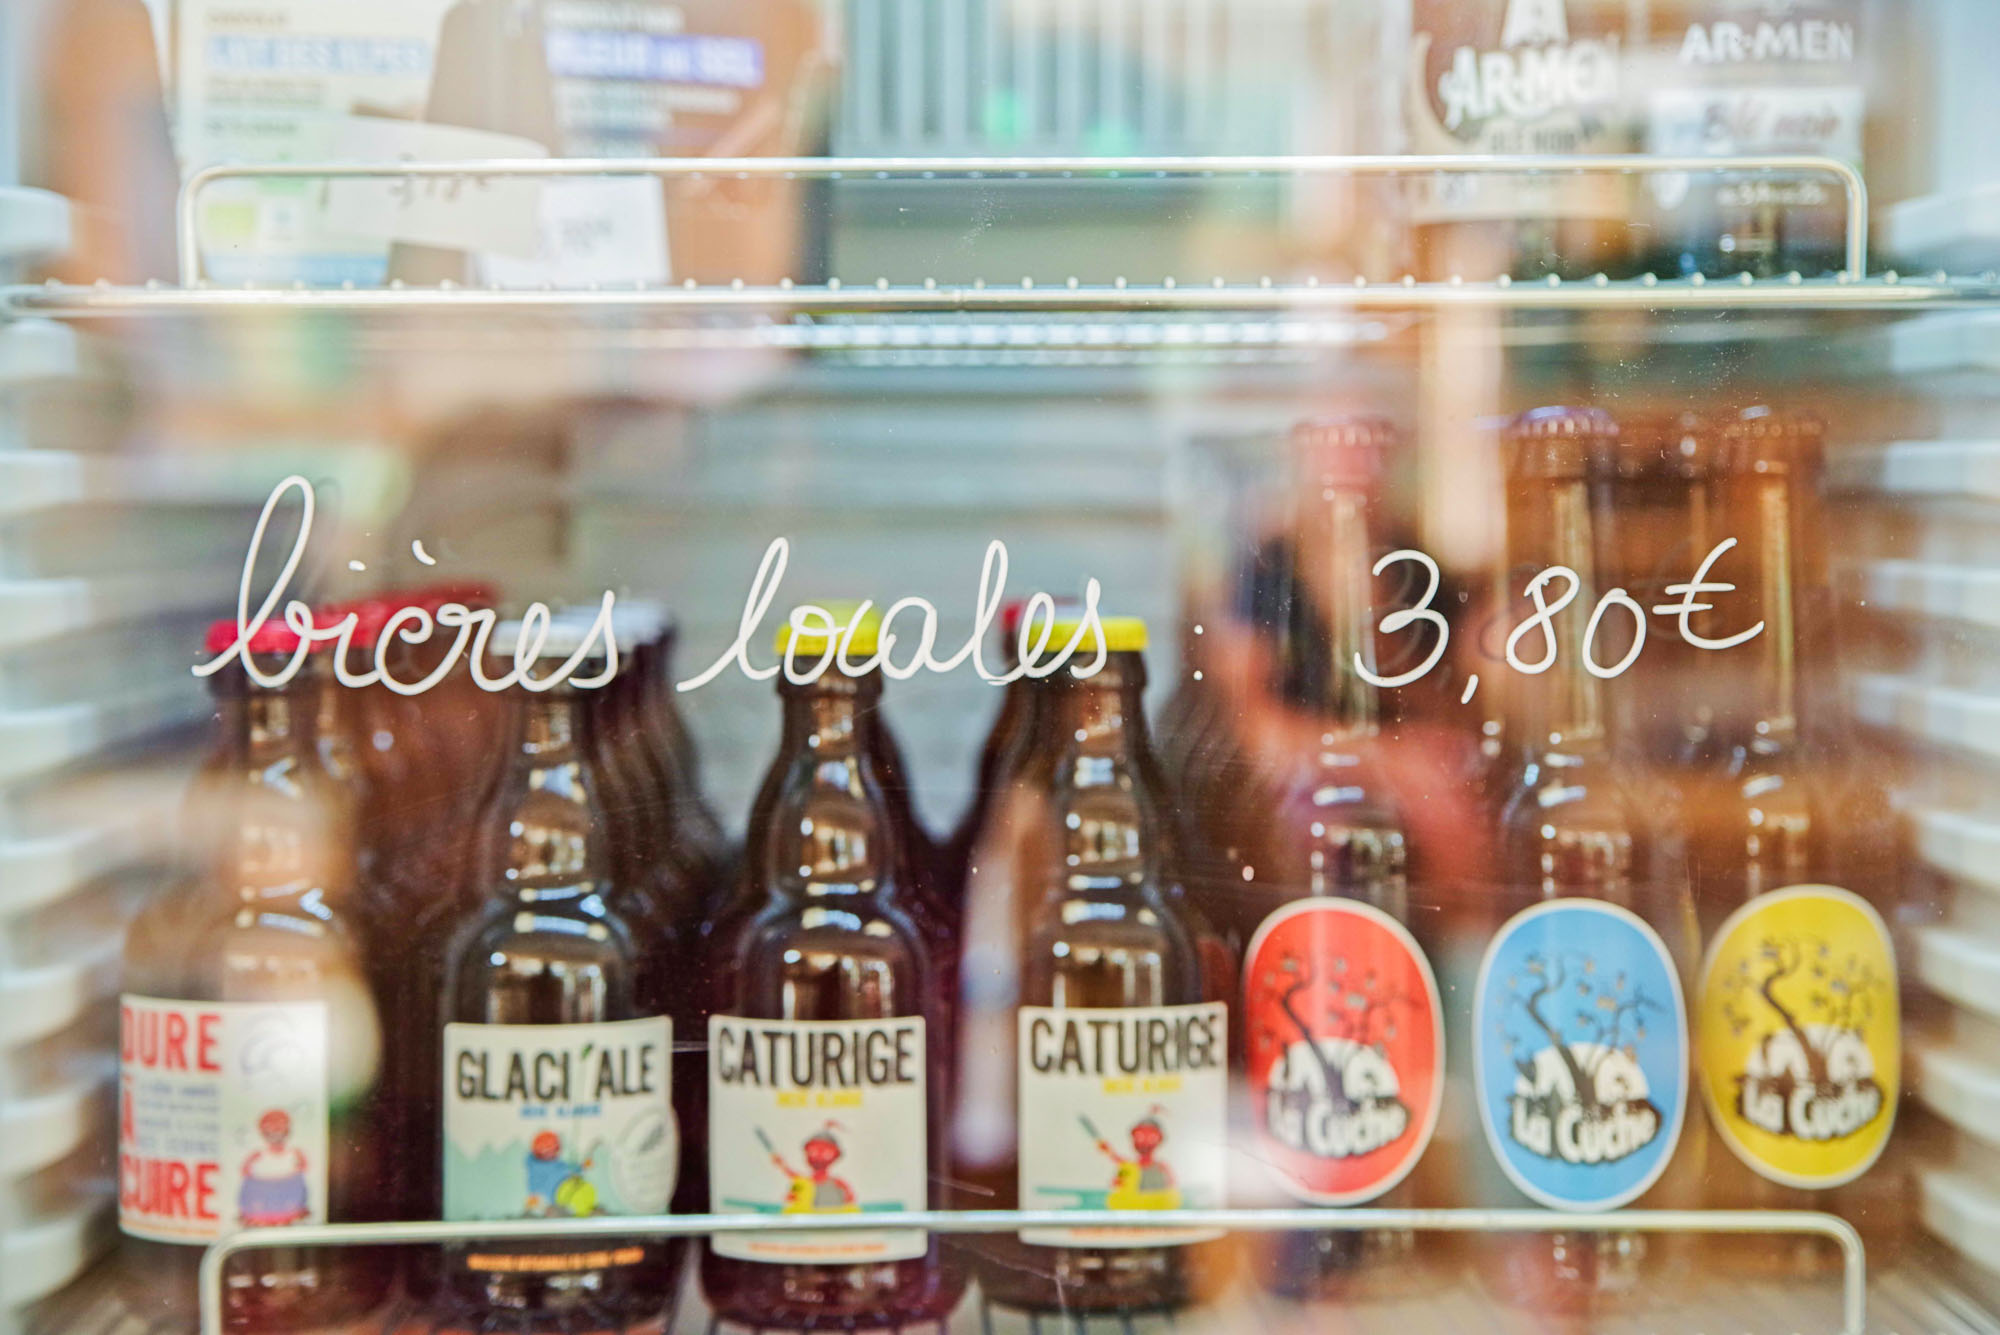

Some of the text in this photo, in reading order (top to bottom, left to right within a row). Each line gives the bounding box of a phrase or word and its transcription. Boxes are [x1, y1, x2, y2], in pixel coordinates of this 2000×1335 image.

[191, 475, 618, 696] bières
[676, 537, 1107, 692] locales
[1354, 537, 1765, 704] 3,80€
[718, 1027, 915, 1087] CATURIGE
[1031, 1014, 1218, 1074] CATURIGE
